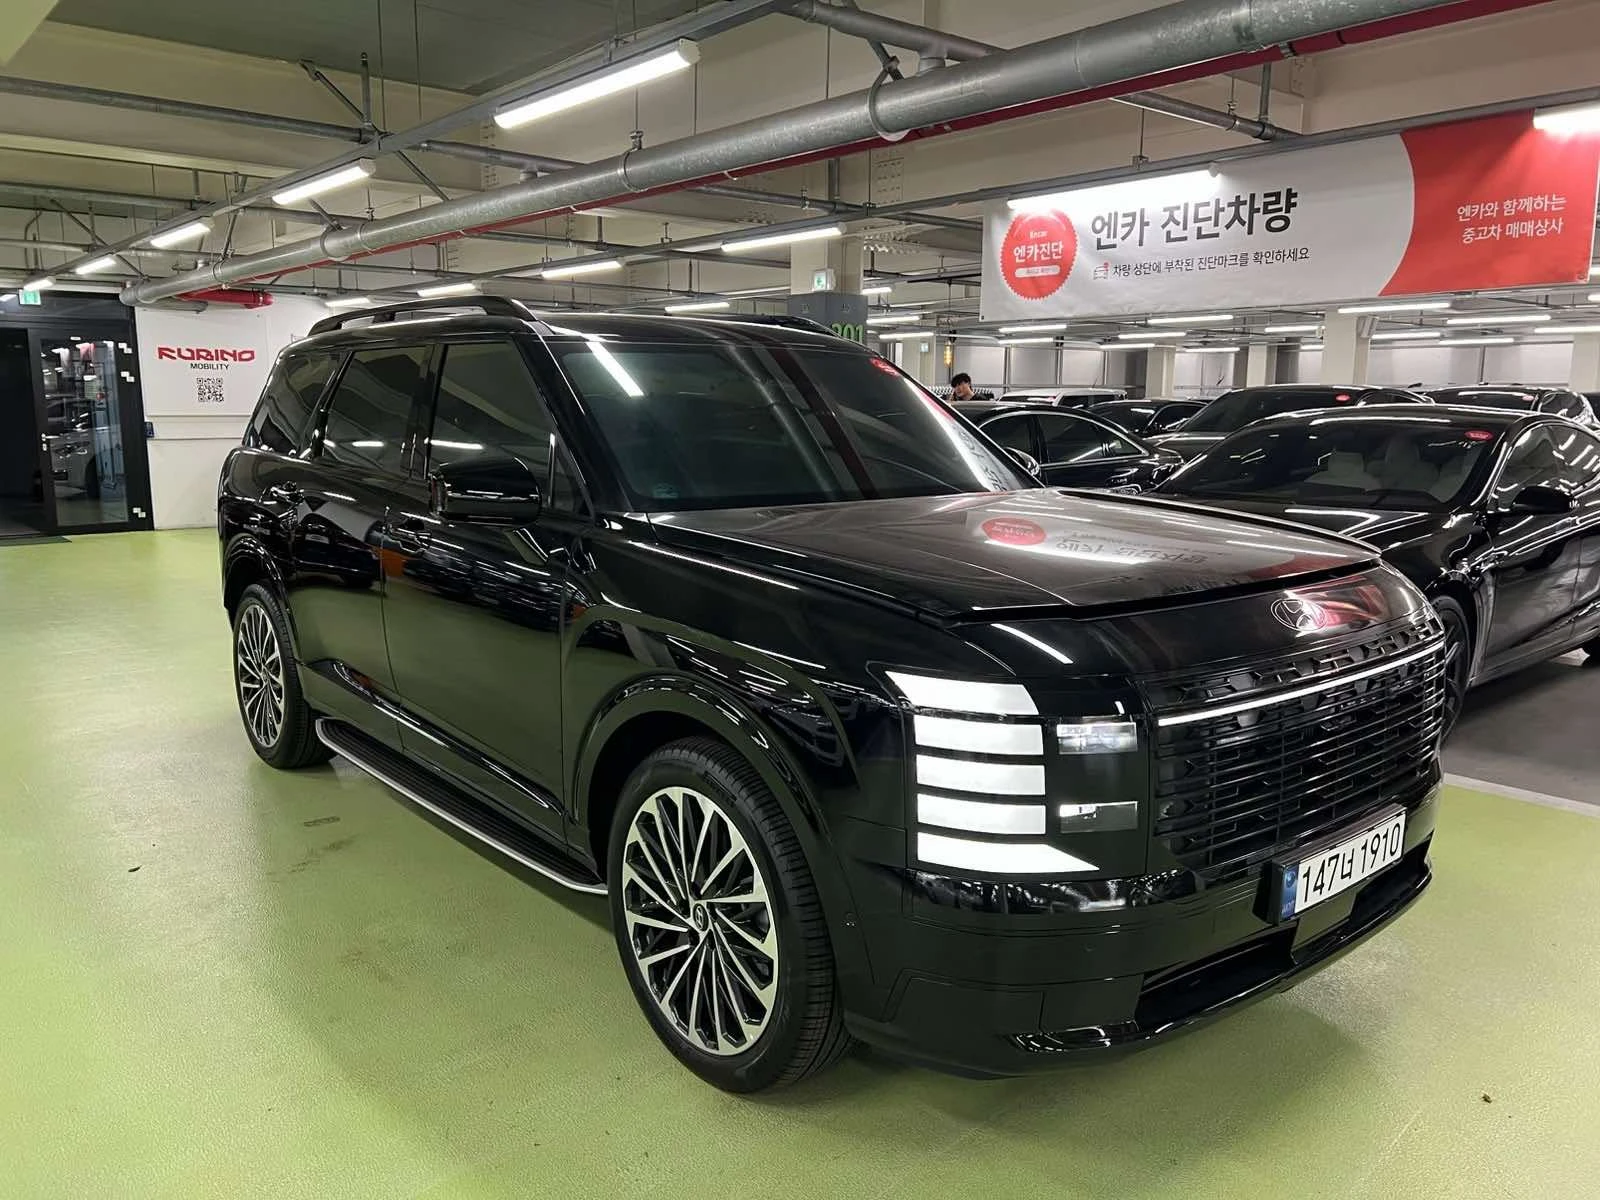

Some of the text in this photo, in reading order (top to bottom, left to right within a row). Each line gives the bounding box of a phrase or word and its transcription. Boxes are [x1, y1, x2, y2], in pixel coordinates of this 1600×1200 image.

[1091, 188, 1298, 250] 엔카 진단차량
[1457, 194, 1567, 222] 엔카와 함께하는
[1462, 218, 1564, 244] 중고차 매매상사
[1013, 240, 1064, 263] 엔카진단
[1113, 247, 1309, 277] 차량 상단에 부착된 진단마크를 확인하세요
[157, 347, 255, 362] RUBINO
[190, 362, 229, 370] MOBILITY
[1302, 823, 1401, 903] 147너 1910
